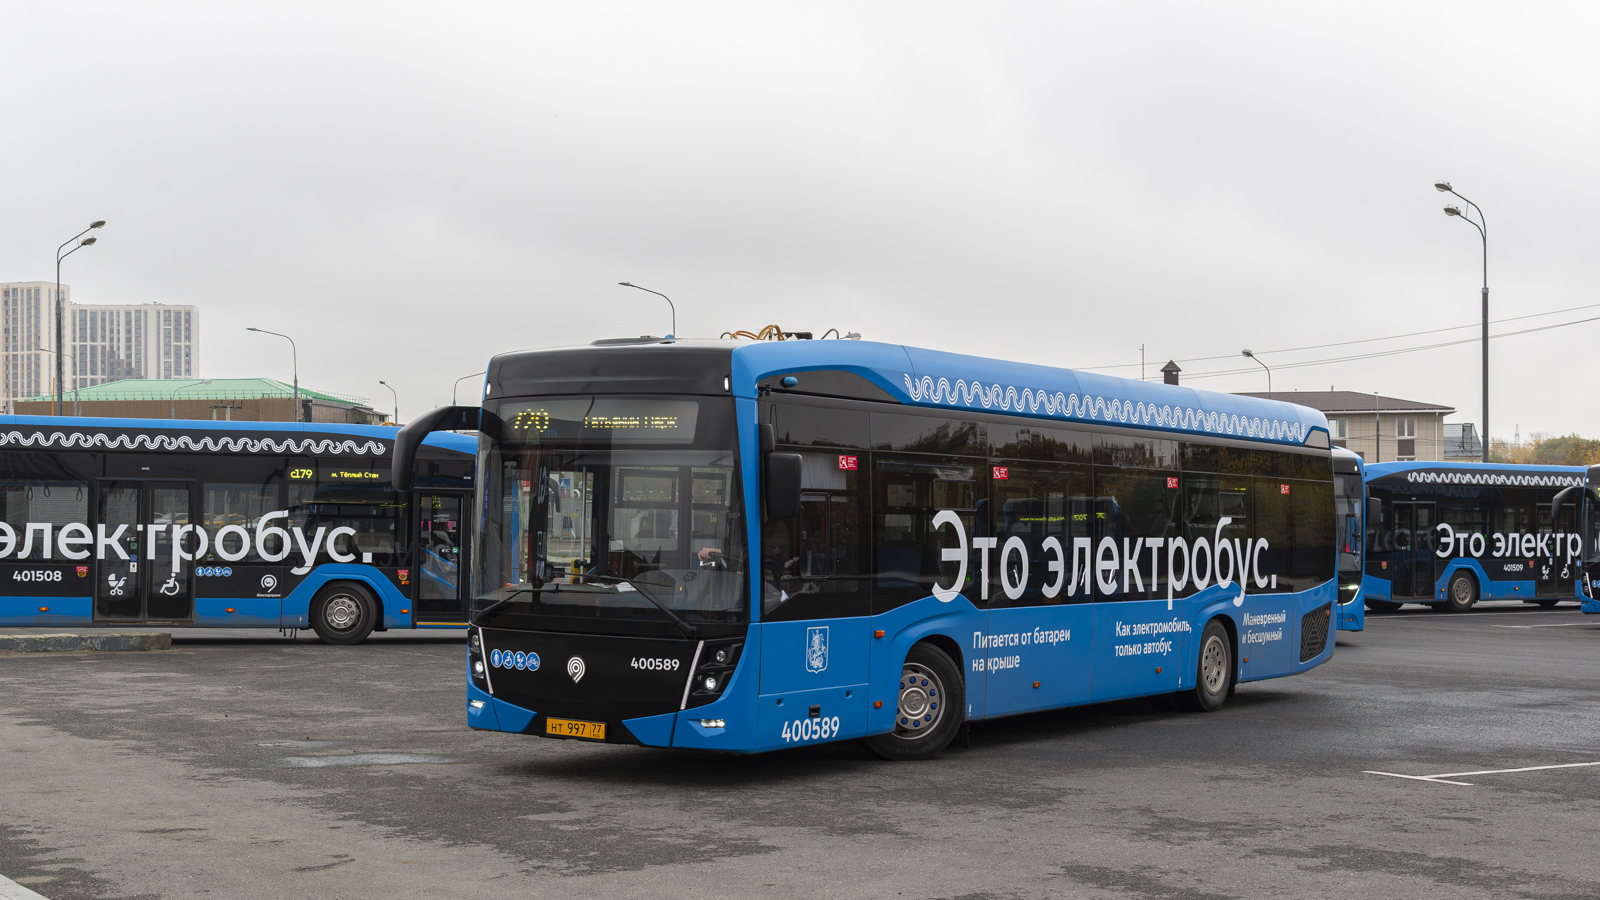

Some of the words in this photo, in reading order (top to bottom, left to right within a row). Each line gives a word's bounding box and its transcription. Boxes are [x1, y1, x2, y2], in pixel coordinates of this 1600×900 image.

[290, 469, 313, 479] с179
[340, 471, 362, 479] Тёплый
[1436, 523, 1485, 558] Это
[932, 510, 1029, 602] Это
[1041, 516, 1277, 610] электробус.
[1503, 563, 1524, 572] 401509
[12, 570, 62, 582] 401508
[1115, 621, 1131, 637] Как
[1132, 617, 1192, 636] электромобиль,
[1243, 611, 1286, 627] Маневренный
[972, 630, 1019, 649] Питается
[1021, 633, 1032, 645] от
[1033, 627, 1071, 646] батареи
[1241, 633, 1246, 644] и
[1247, 628, 1283, 644] бесшумный
[1115, 643, 1141, 656] только
[1143, 640, 1172, 656] автобус
[631, 657, 680, 671] 400589
[972, 659, 985, 672] на
[987, 654, 1020, 674] крыше
[567, 722, 586, 735] 997
[592, 723, 602, 734] 77
[781, 716, 840, 742] 400589
